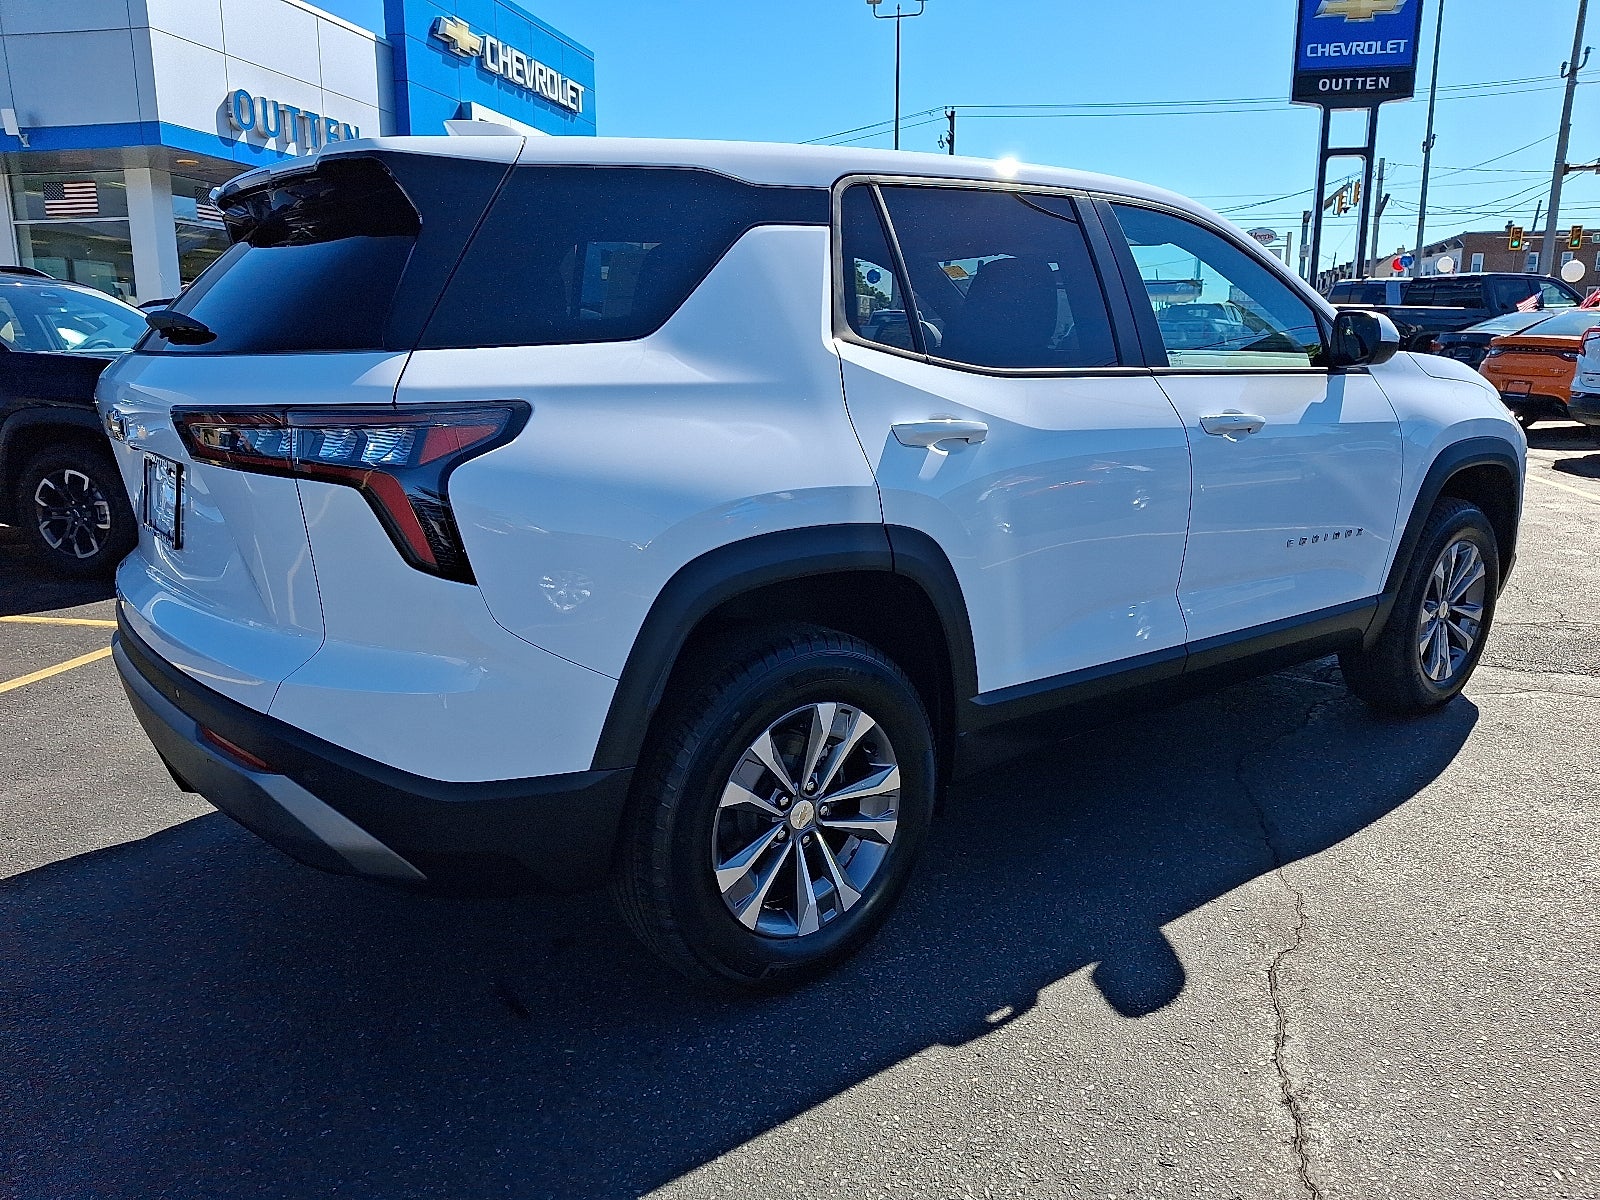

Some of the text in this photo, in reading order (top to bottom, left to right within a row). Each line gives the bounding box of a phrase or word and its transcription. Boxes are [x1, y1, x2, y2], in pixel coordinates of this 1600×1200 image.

[1306, 39, 1409, 57] CHEVROLET
[483, 35, 585, 113] CHEVROLET
[1318, 76, 1391, 92] OUTTEN
